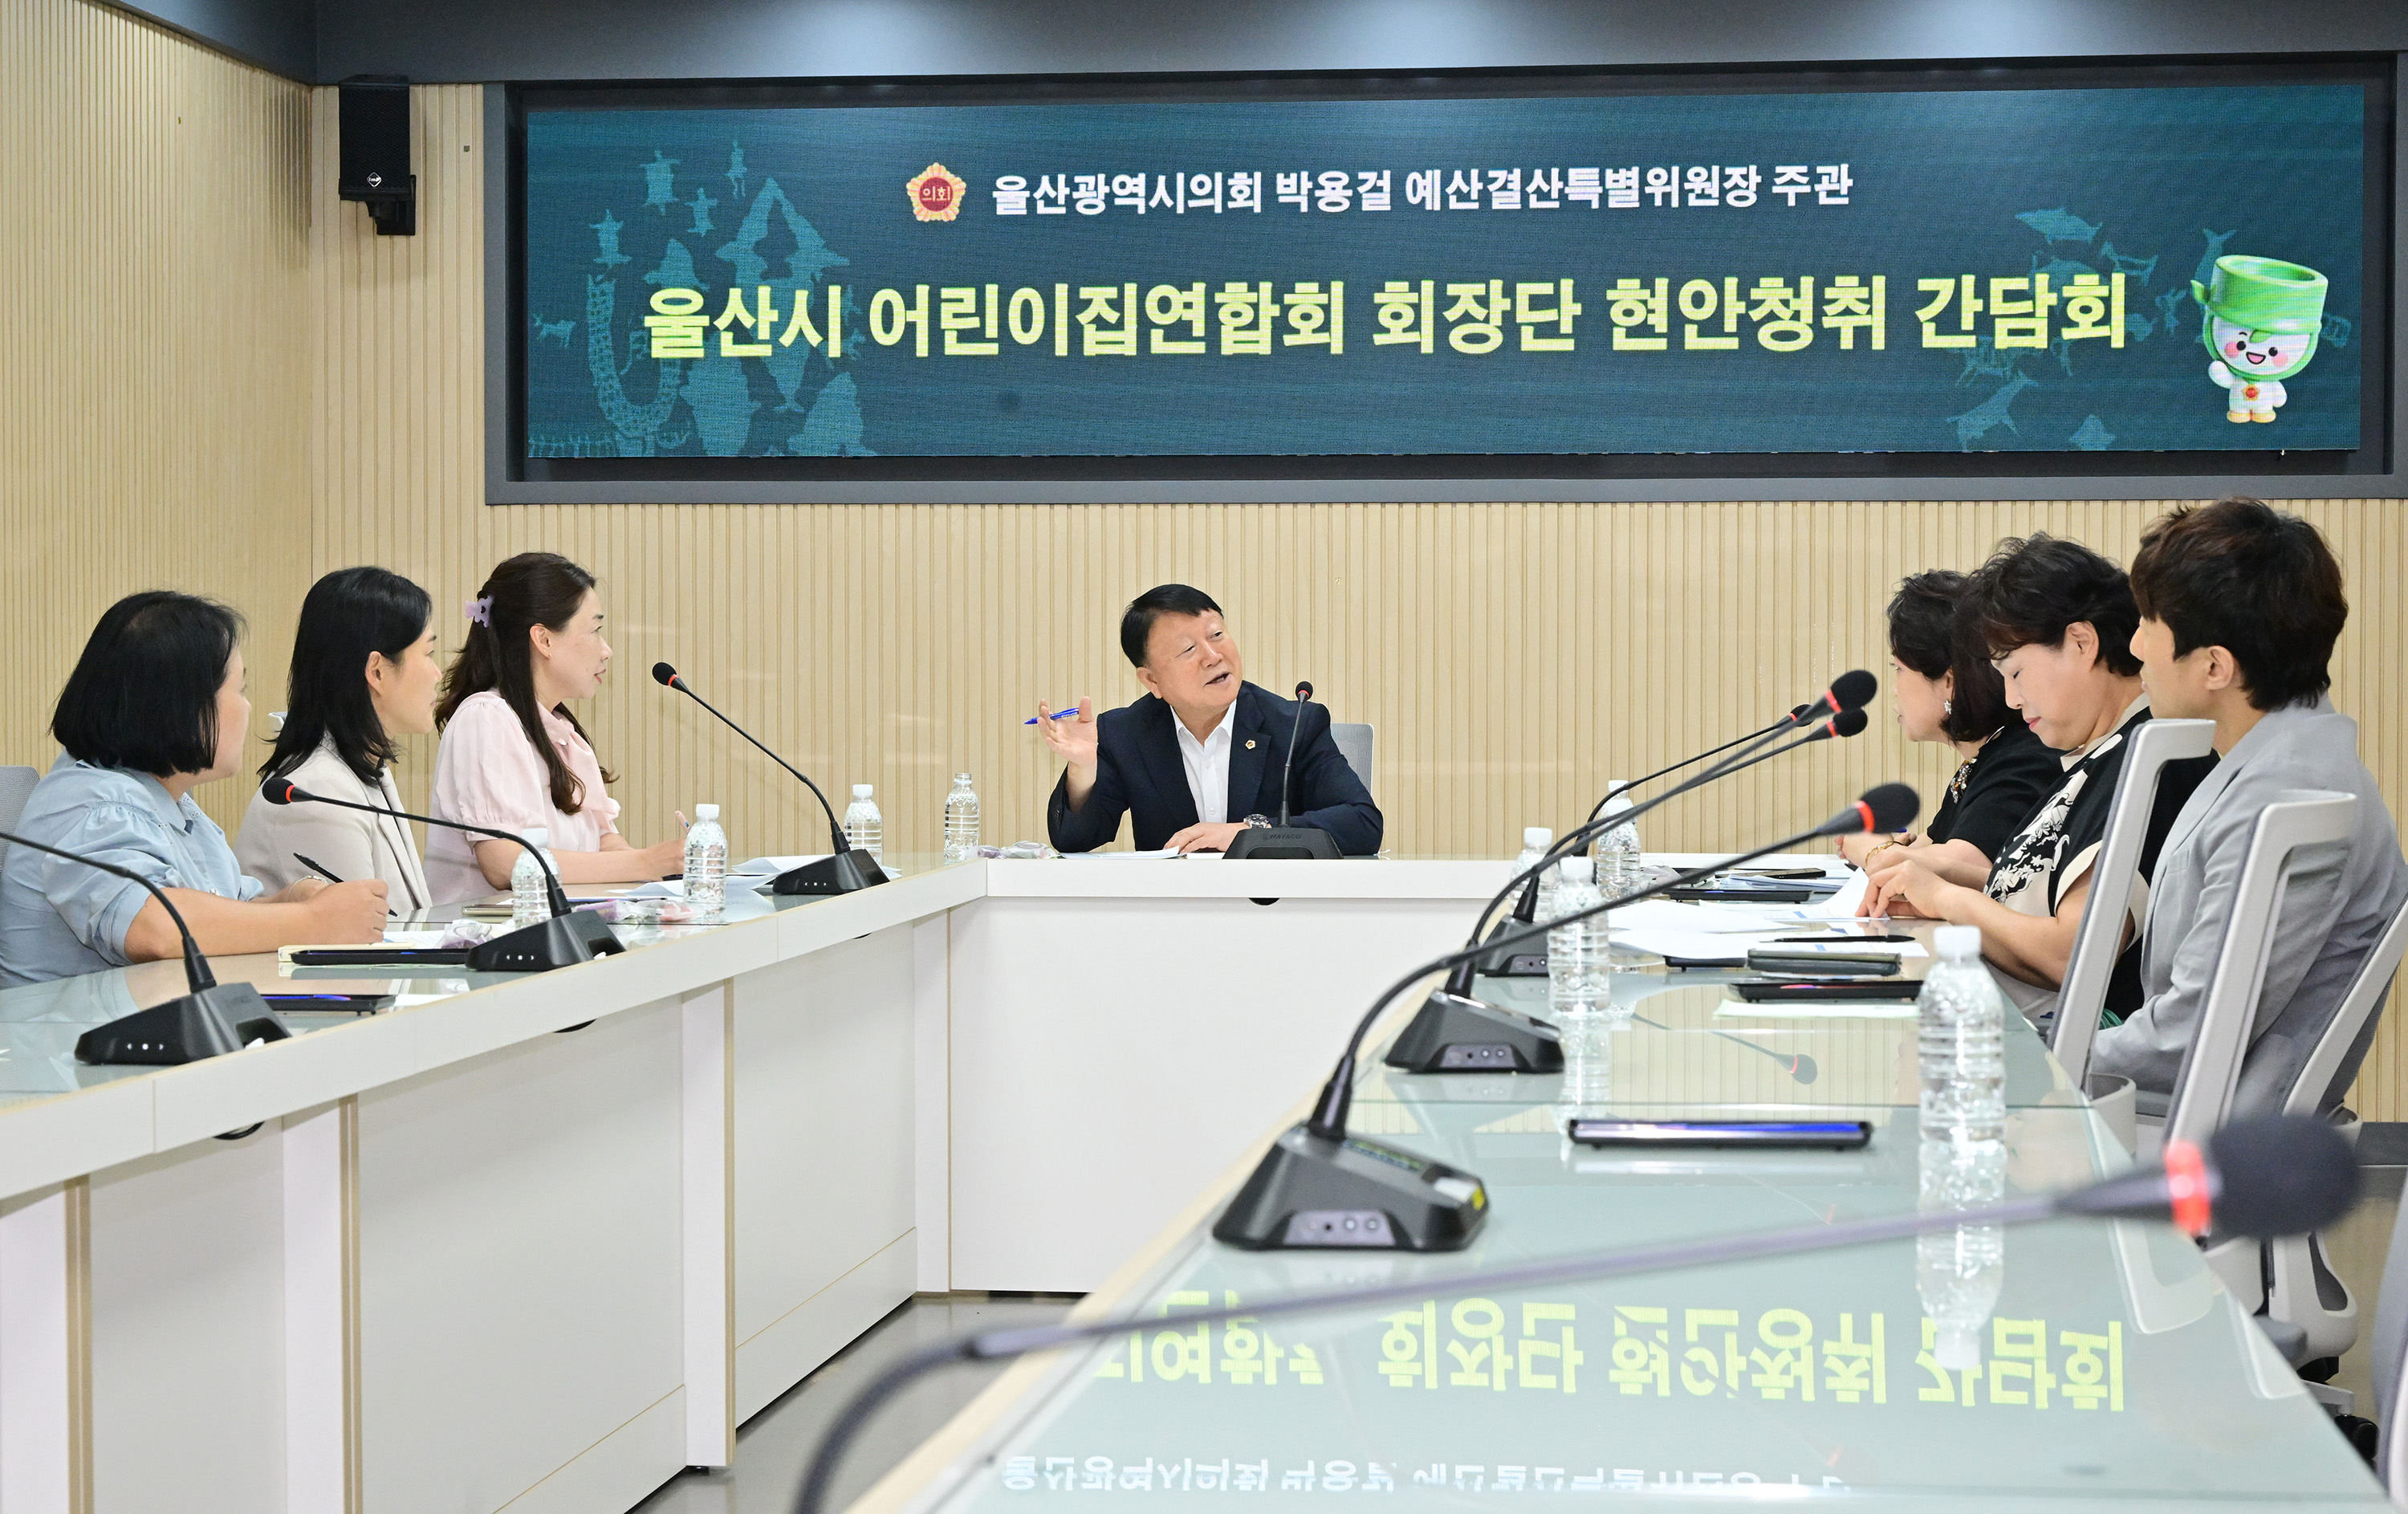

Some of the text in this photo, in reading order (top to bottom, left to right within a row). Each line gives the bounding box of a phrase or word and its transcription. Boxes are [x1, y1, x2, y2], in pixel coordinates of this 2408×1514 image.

[921, 184, 953, 202] 의회
[992, 163, 1853, 215] 울산광역시의회 박용걸 예산결산특별위원장 주관
[644, 273, 2125, 358] 울산시 어린이집연합회 회장단 현안청취 간담회
